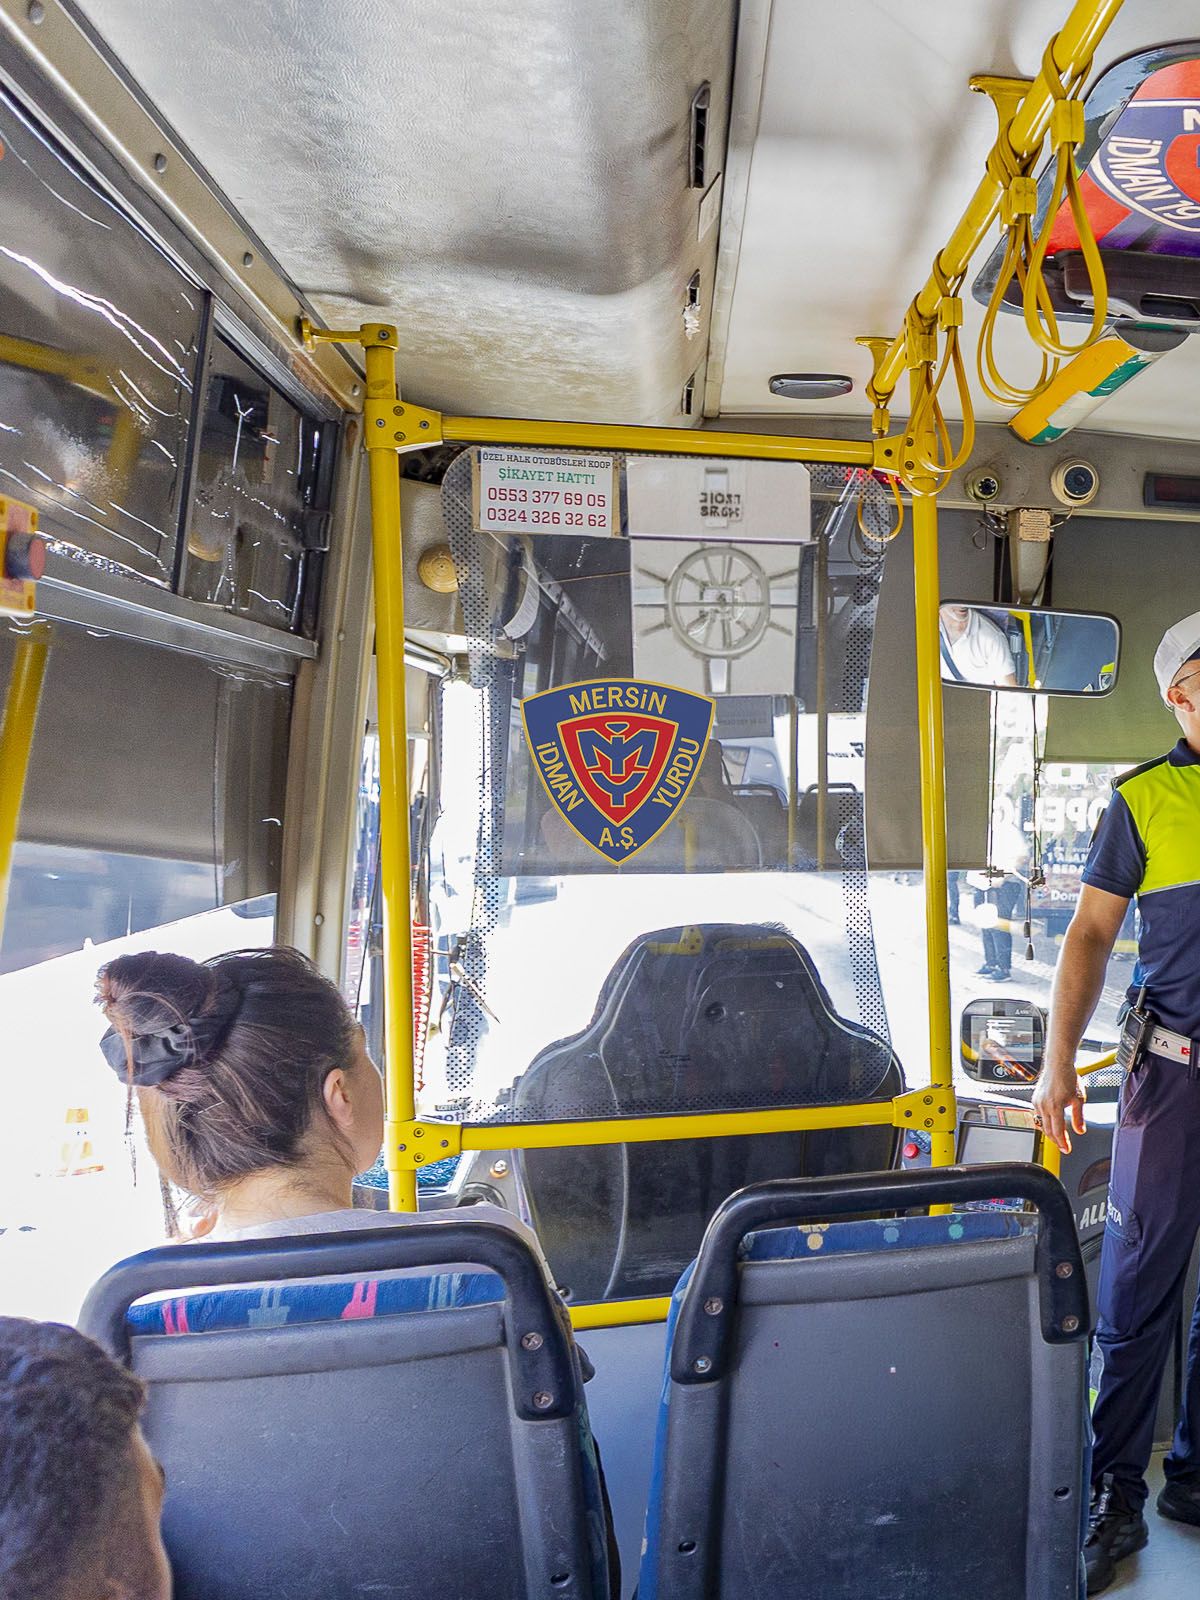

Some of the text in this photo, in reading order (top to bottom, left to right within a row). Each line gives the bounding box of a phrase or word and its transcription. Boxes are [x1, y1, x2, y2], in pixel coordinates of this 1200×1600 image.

[482, 452, 611, 469] ÖZEL HALK OTOBÜSLERİ KOOP
[498, 466, 595, 485] ŞİKAYET HATTI
[488, 487, 606, 507] 0553 377 69 05
[487, 507, 607, 527] 0324 326 32 62
[652, 737, 701, 809] YURDU
[598, 827, 638, 850] A.Ş.
